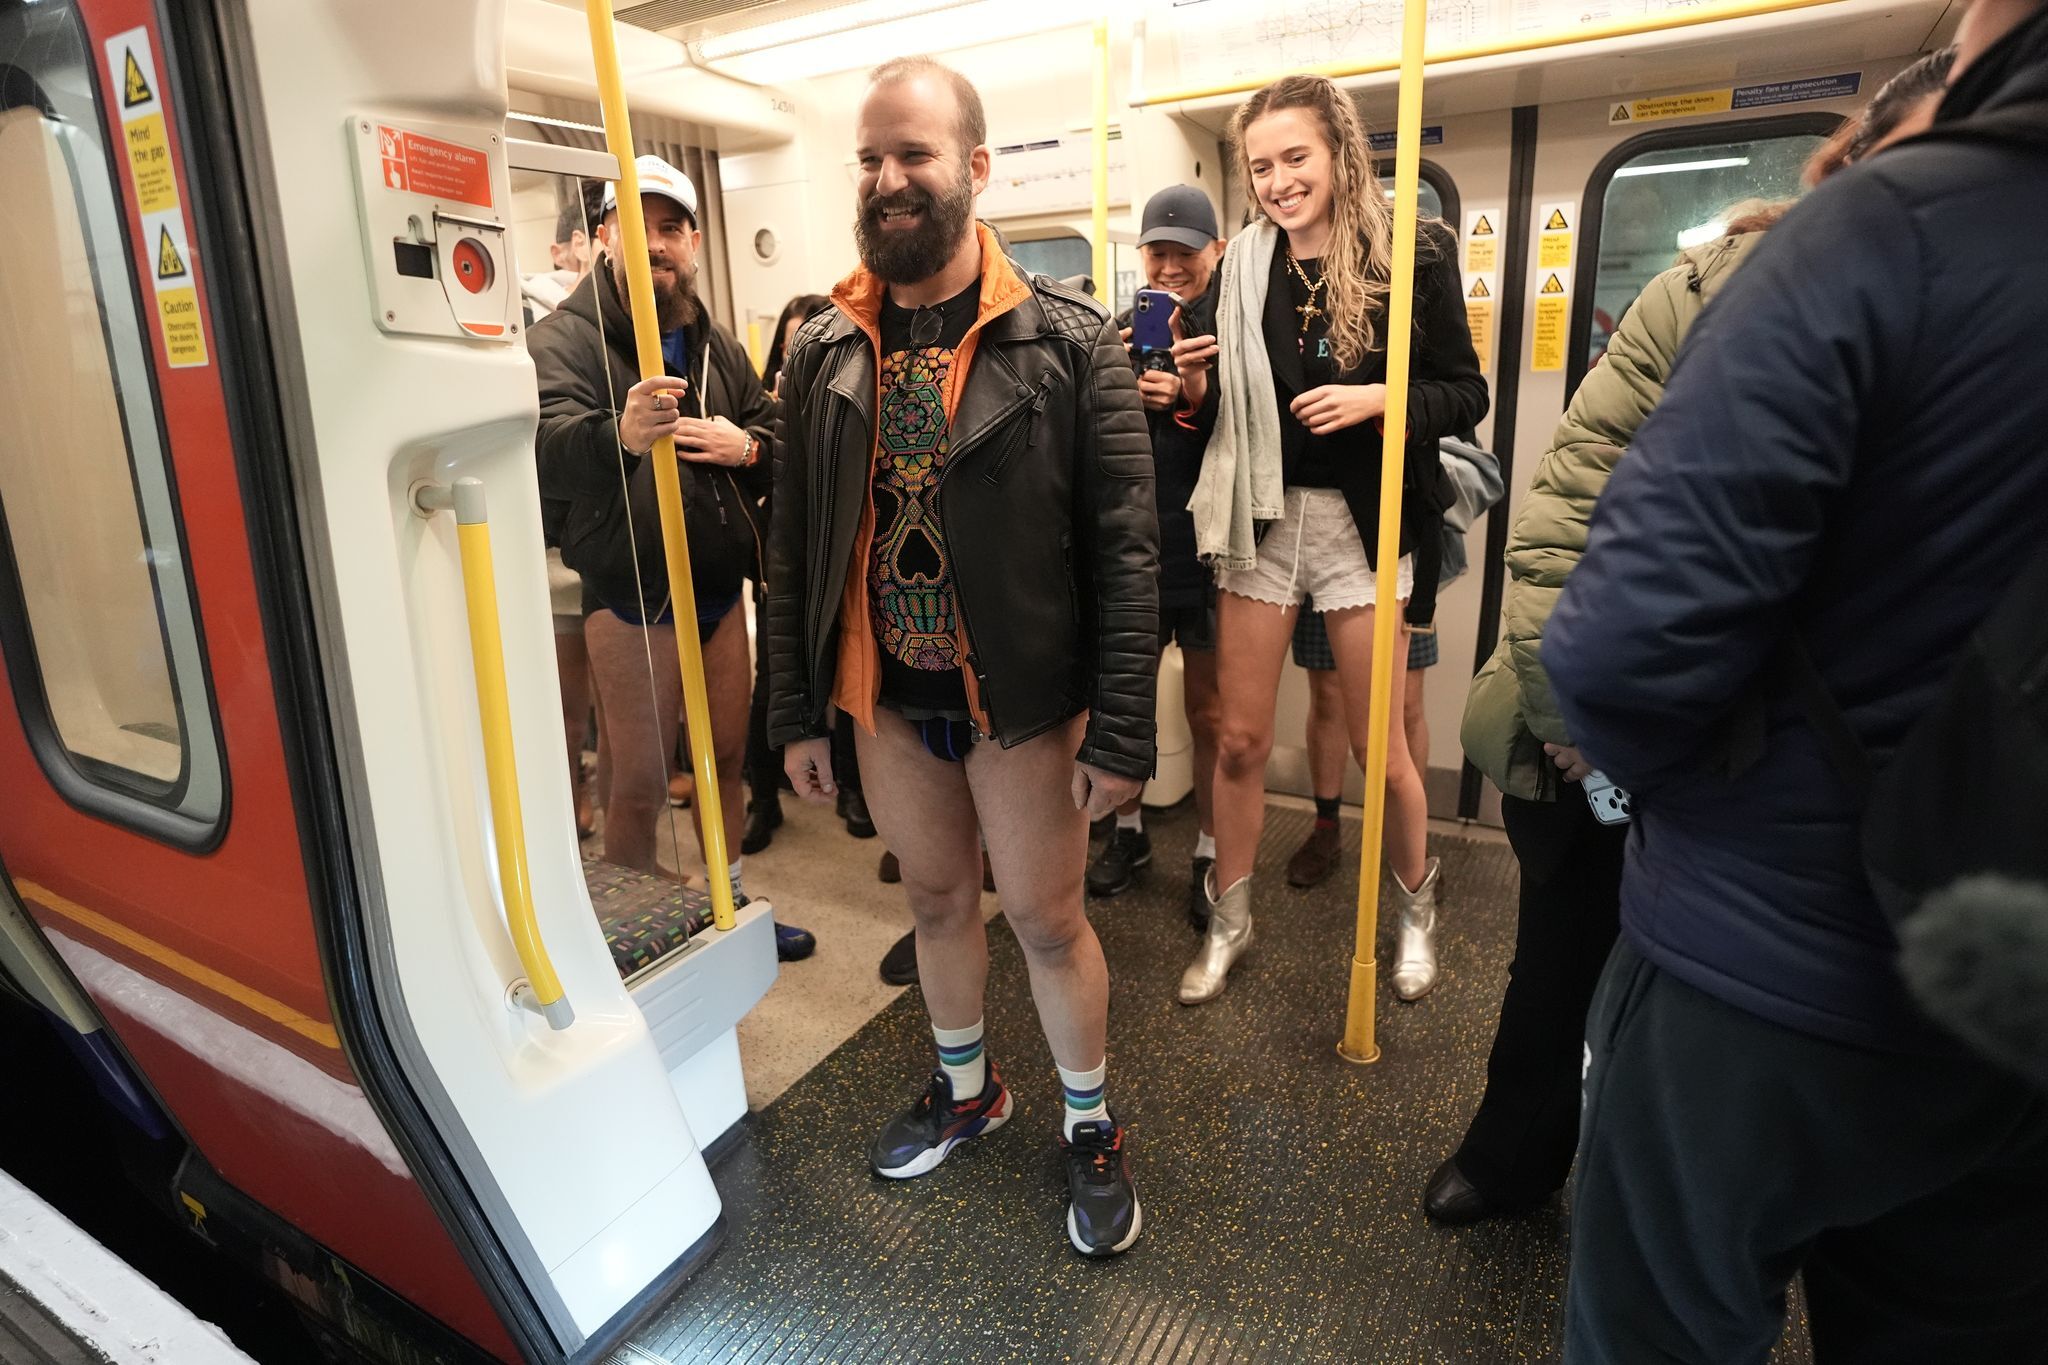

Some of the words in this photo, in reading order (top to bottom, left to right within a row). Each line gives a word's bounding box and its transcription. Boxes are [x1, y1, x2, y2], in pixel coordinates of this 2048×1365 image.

[1736, 88, 1763, 98] Penalty
[1765, 86, 1780, 94] fare
[1791, 78, 1838, 91] prosecution
[1636, 99, 1679, 111] Obstructing
[1680, 98, 1693, 106] the
[1694, 96, 1715, 104] doors
[1636, 110, 1649, 118] can
[1650, 108, 1659, 116] be
[1661, 105, 1696, 115] dangerous
[129, 125, 151, 142] Mind
[134, 149, 149, 163] the
[150, 145, 165, 162] gap
[408, 139, 453, 161] Emergency
[454, 152, 477, 165] alarm
[164, 300, 194, 314] Caution
[168, 322, 197, 332] Obstructing
[170, 333, 178, 342] the
[178, 334, 194, 342] doors
[172, 345, 197, 354] dangerous
